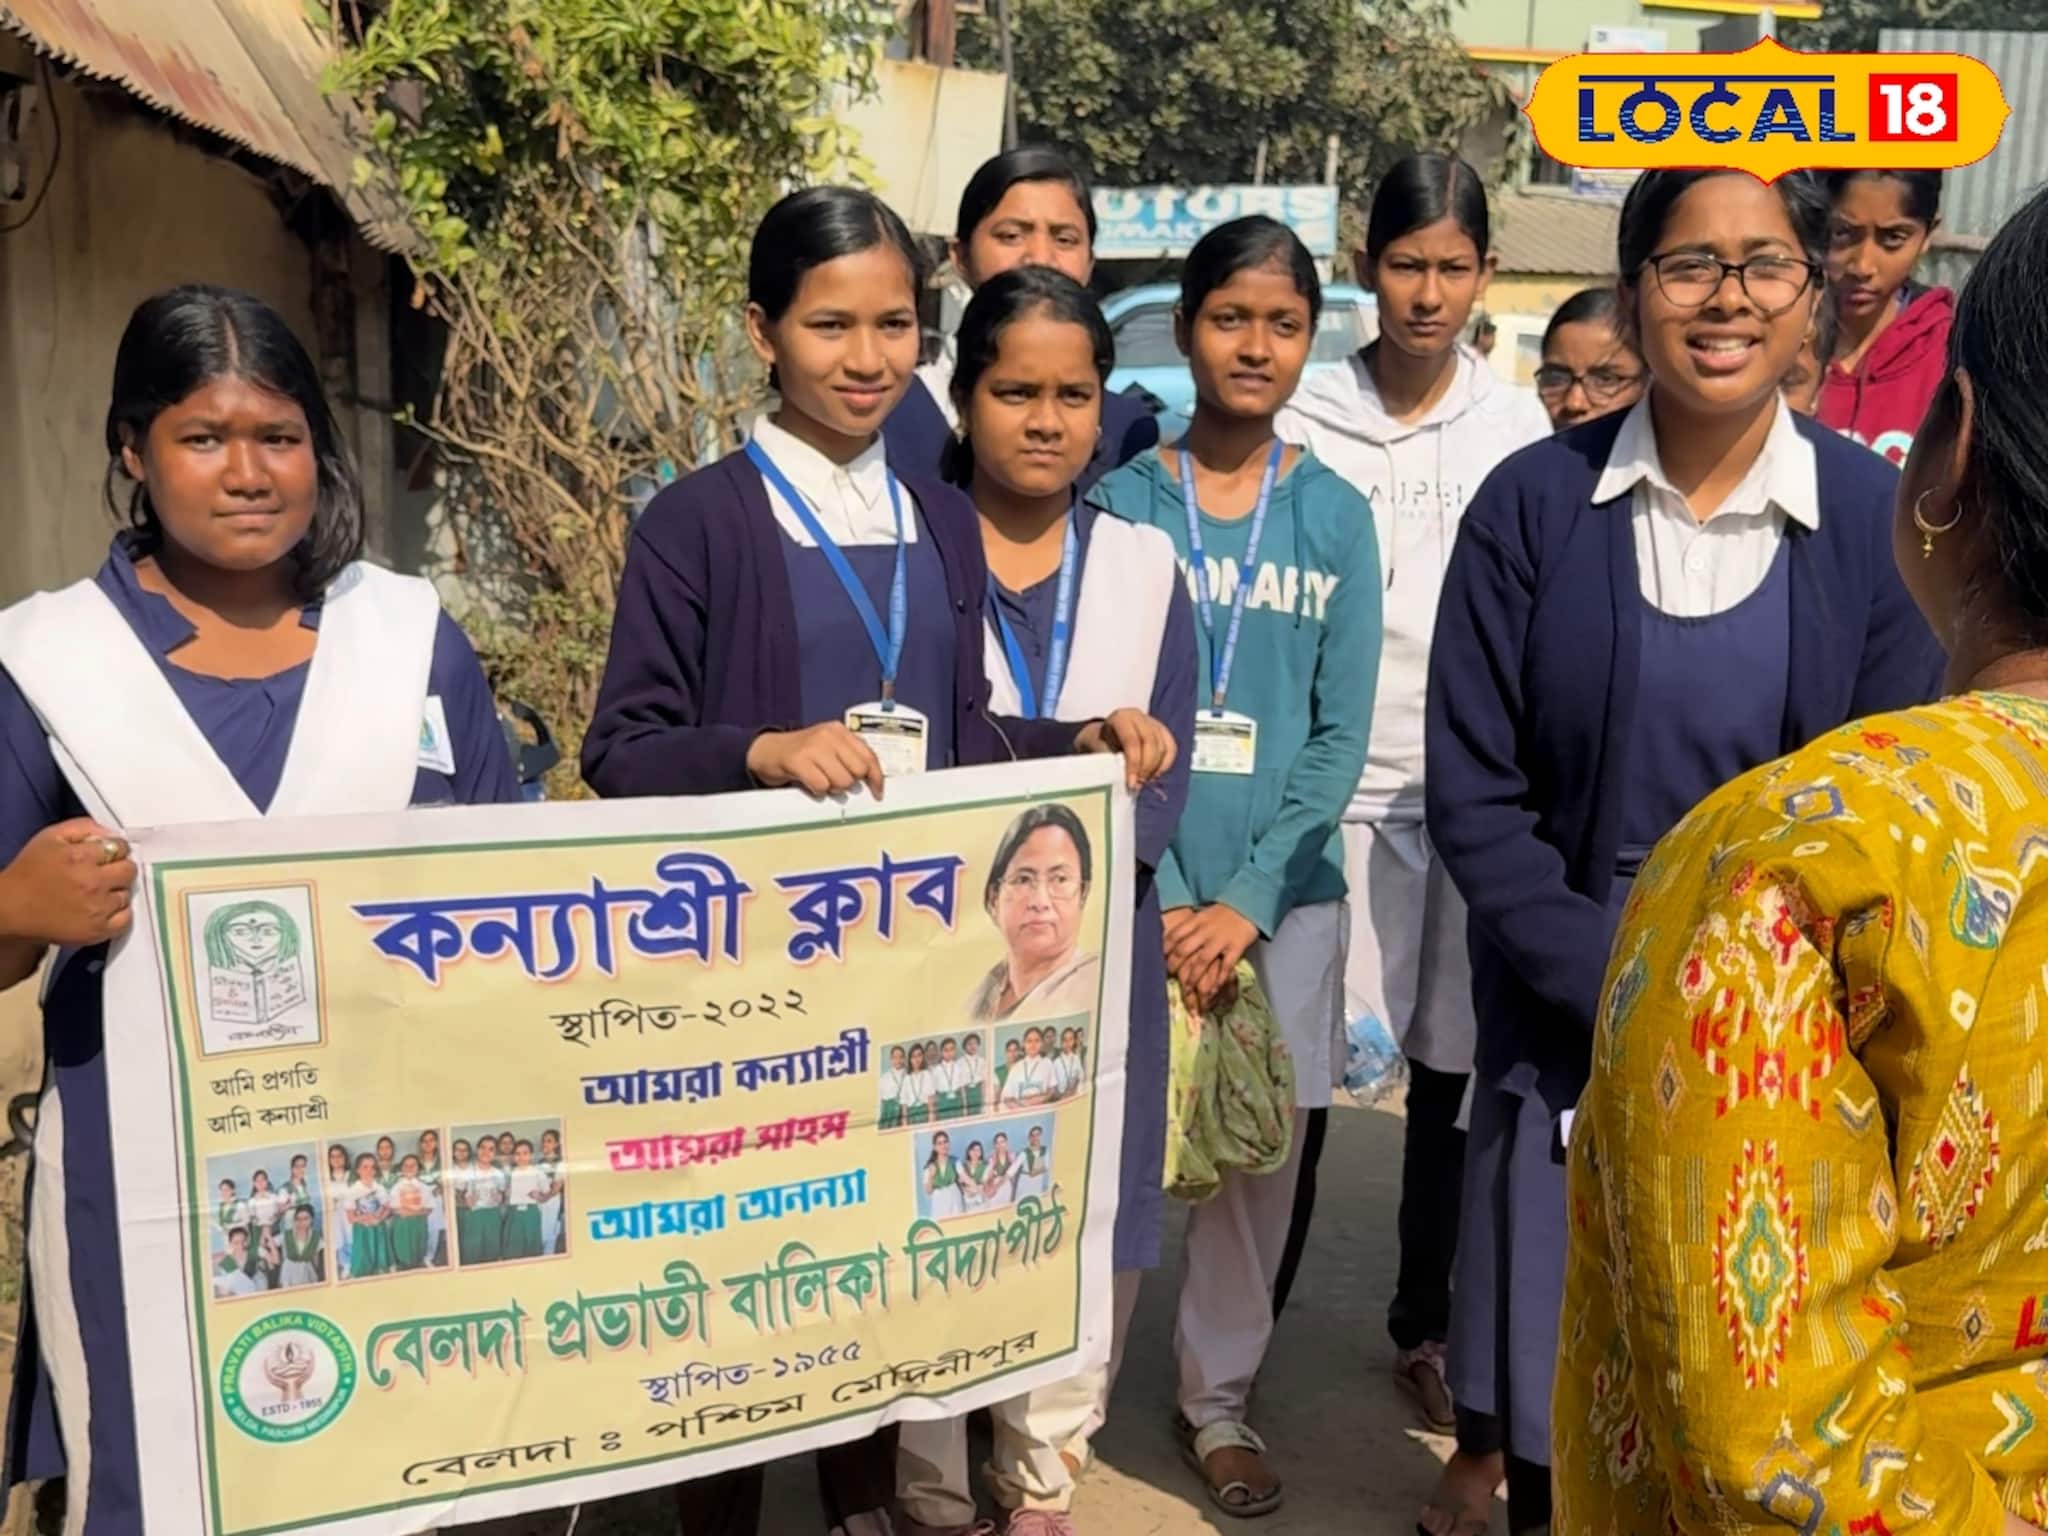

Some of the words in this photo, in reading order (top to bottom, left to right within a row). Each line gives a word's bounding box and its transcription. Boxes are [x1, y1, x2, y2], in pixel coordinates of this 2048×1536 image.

[351, 852, 754, 984] কন্যাশ্রী
[774, 850, 967, 963] ক্লাব
[550, 989, 807, 1047] স্থাপিত-২০২২
[209, 1068, 255, 1096] আমি
[262, 1061, 318, 1090] প্রগতি
[580, 1061, 723, 1105] আমরা
[732, 1027, 870, 1091] কন্যাশ্রী
[207, 1105, 251, 1134] আমি
[256, 1096, 328, 1126] কন্যাশ্রী
[605, 1126, 747, 1171] আমরা
[587, 1195, 726, 1241] আমরা
[736, 1168, 867, 1221] অনন্যা
[366, 1297, 529, 1388] বেলদা
[545, 1259, 711, 1359] প্রভাতী
[721, 1241, 890, 1331] বালিকা
[902, 1185, 1066, 1300] বিদ্যাপীঠ
[640, 1341, 861, 1406] স্থাপিত-১৯৫৫
[262, 1403, 290, 1417] ESTD
[402, 1436, 576, 1486] বেলদা
[646, 1393, 806, 1438] পশ্চিম
[832, 1331, 1038, 1402] মেদিনীপুর
